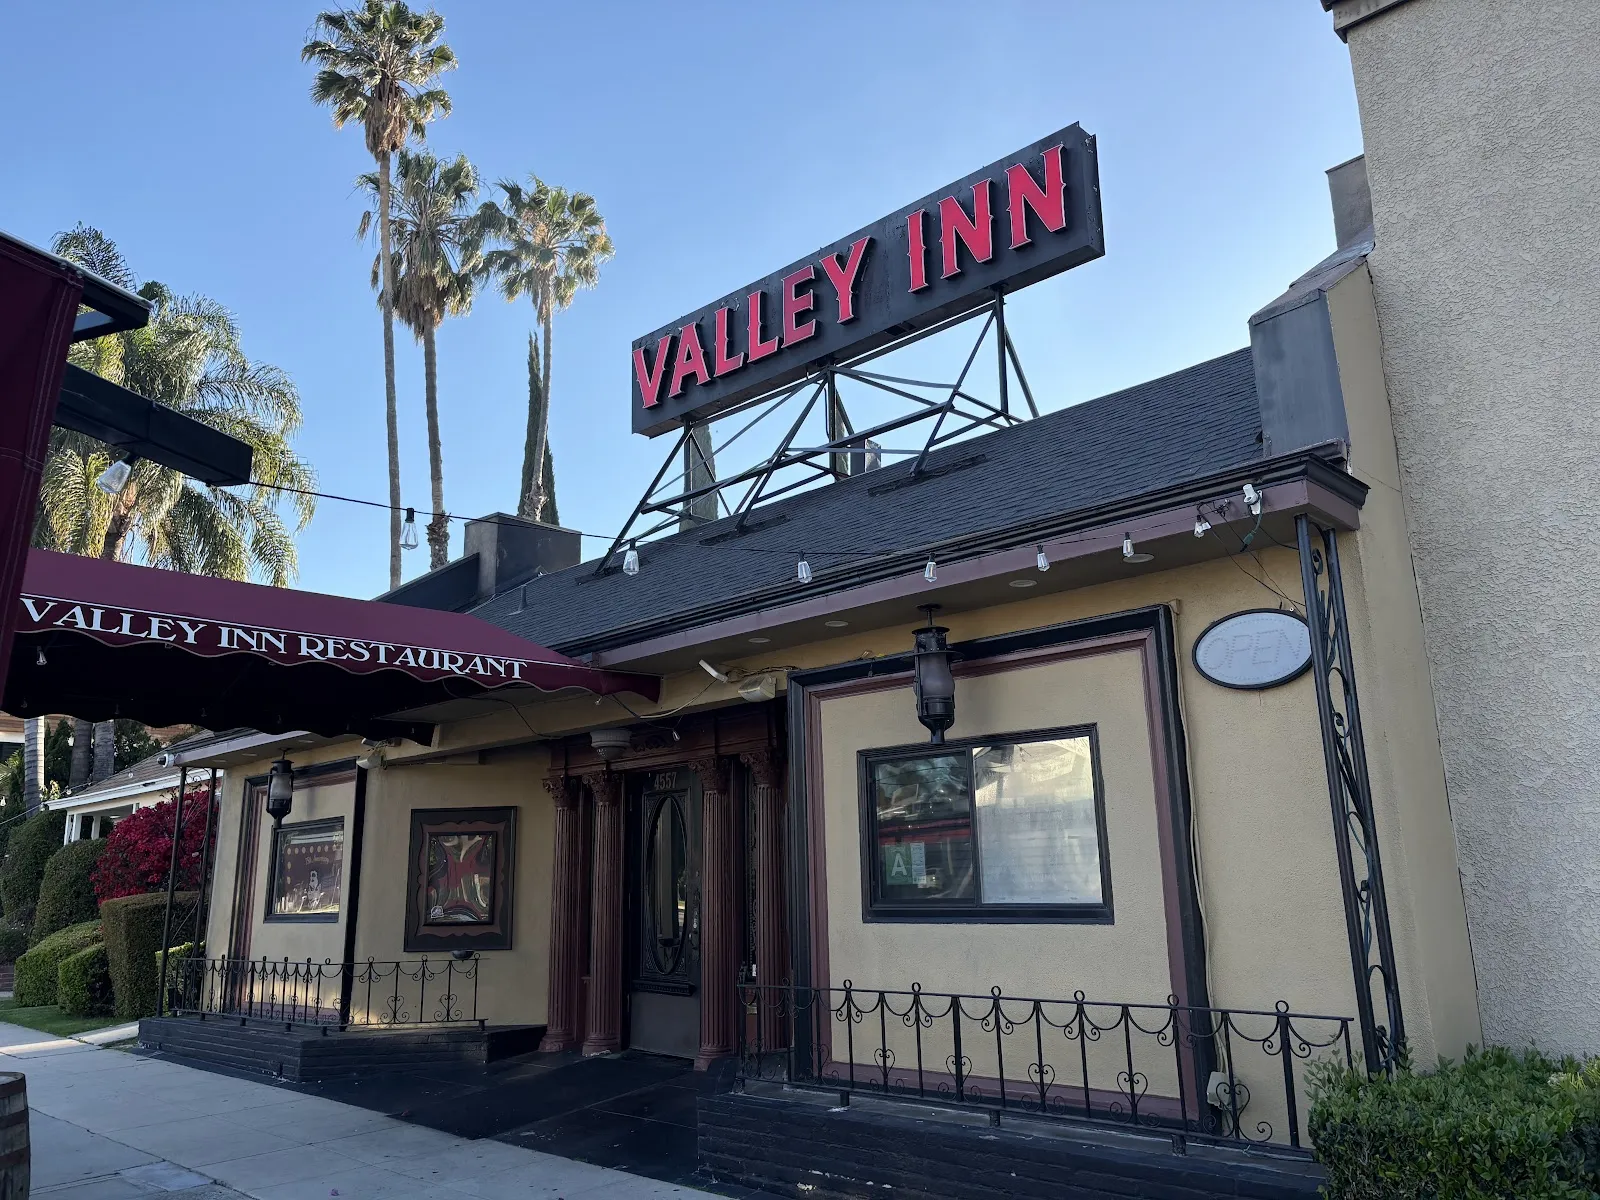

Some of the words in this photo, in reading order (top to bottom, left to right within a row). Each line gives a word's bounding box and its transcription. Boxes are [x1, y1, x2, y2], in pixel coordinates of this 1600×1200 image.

[632, 236, 871, 409] VALLEY
[905, 144, 1067, 293] INN
[20, 598, 208, 644] VALLEY
[217, 626, 288, 654] INN
[298, 635, 528, 679] RESTAURANT
[1203, 628, 1305, 670] OPEN
[653, 771, 677, 791] 4557
[891, 852, 908, 876] A
